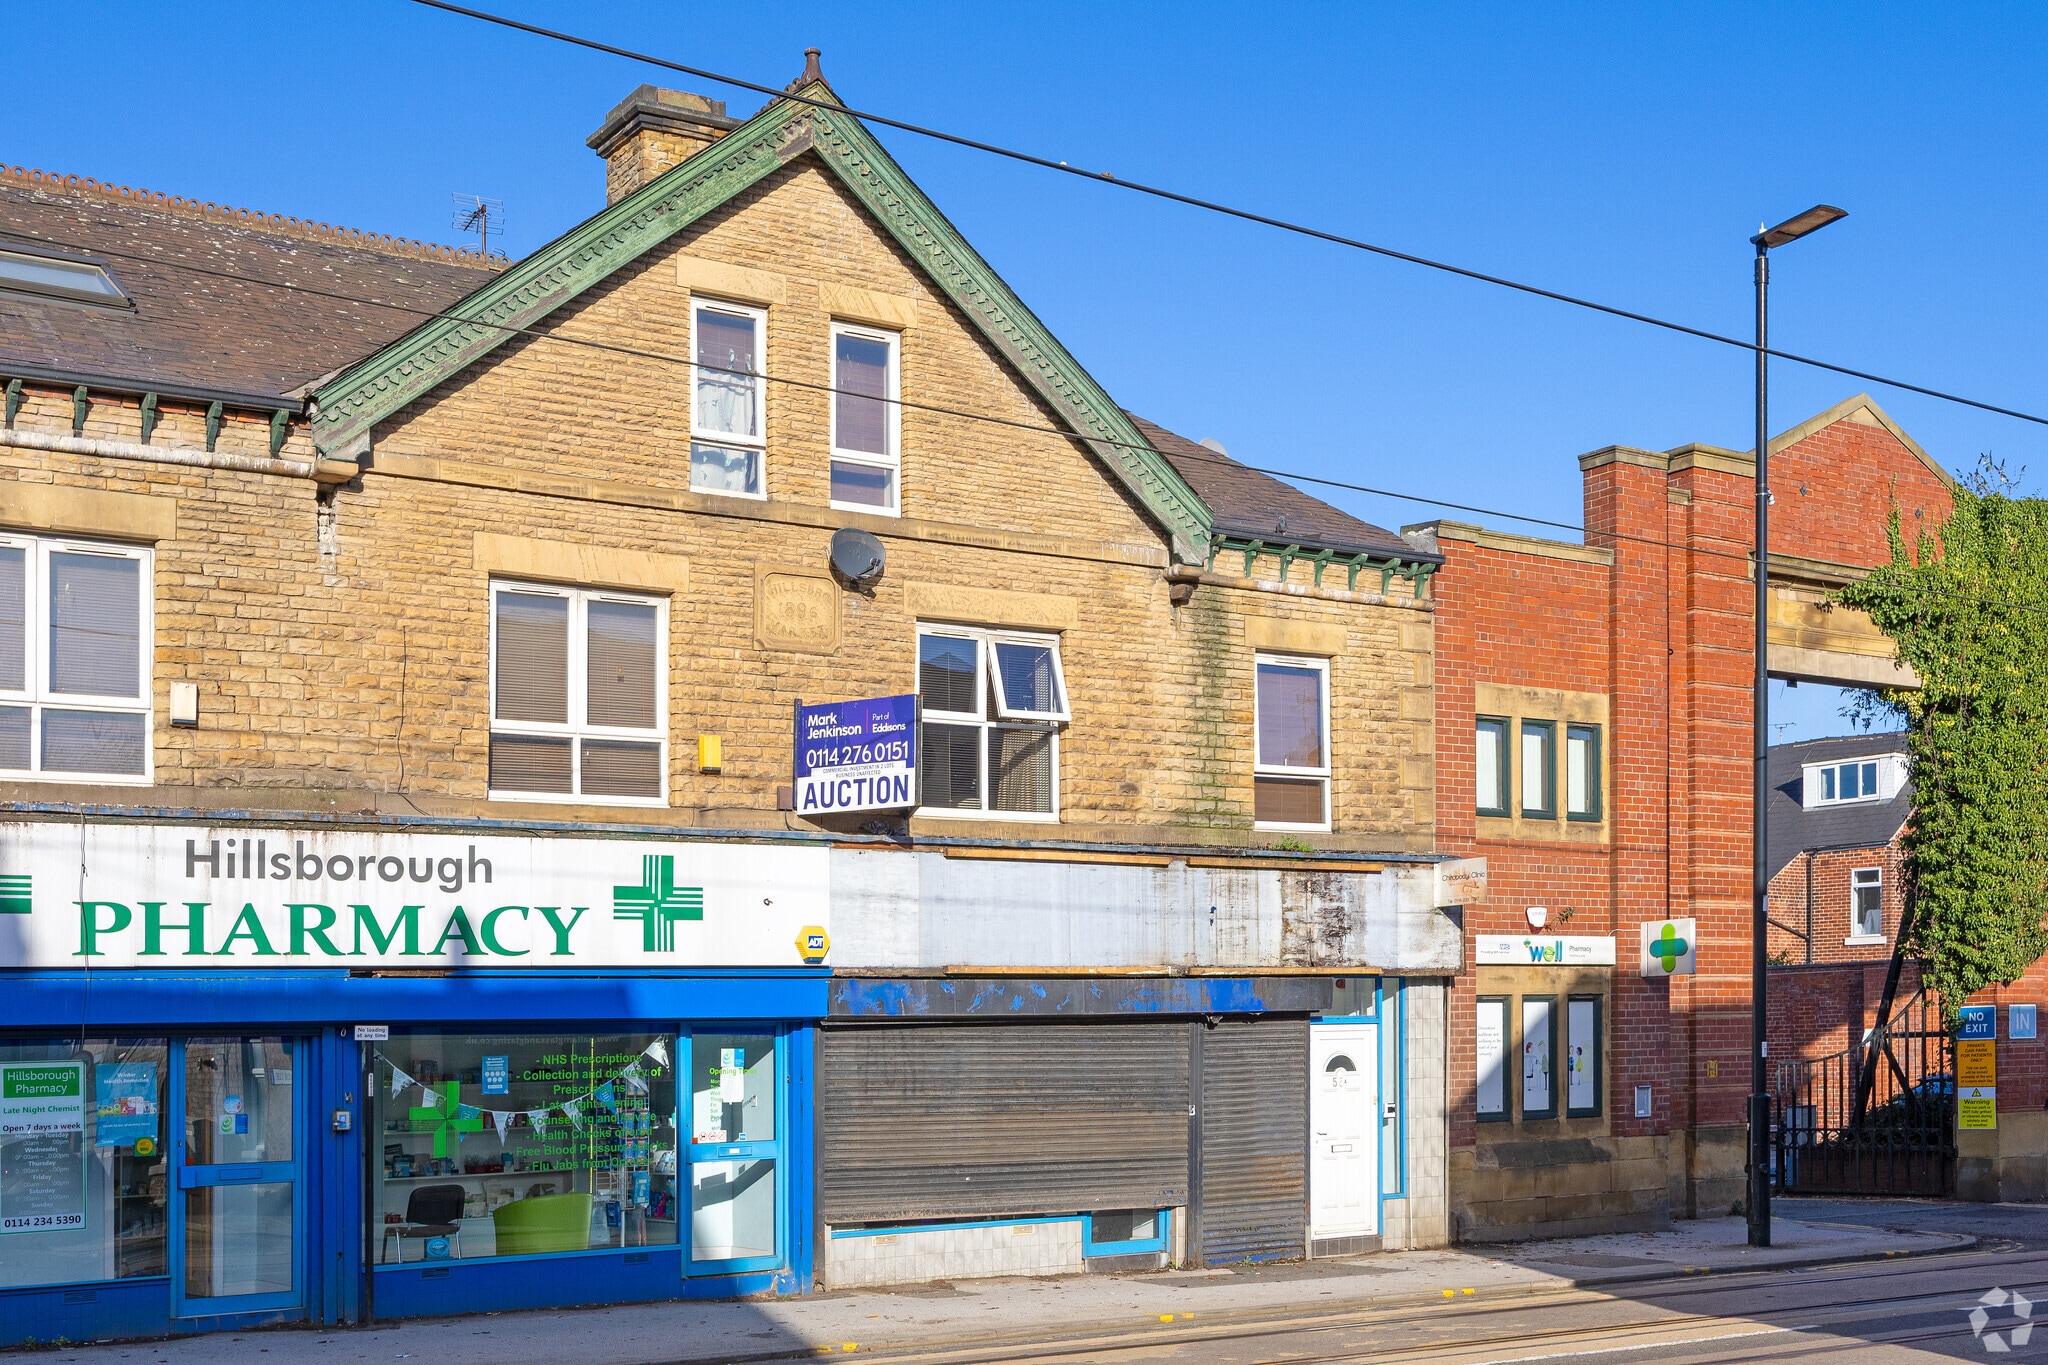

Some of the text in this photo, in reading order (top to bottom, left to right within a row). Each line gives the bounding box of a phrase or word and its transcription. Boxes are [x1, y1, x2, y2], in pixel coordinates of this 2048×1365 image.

[808, 712, 837, 727] Mark
[873, 712, 890, 721] Part of
[808, 725, 862, 740] Jenkinson
[873, 722, 906, 734] Eddisons
[806, 741, 908, 768] 0114 276 0151
[803, 775, 908, 810] AUCTION
[185, 839, 493, 893] Hillsborough
[72, 901, 590, 956] PHARMACY
[808, 937, 824, 948] ADT
[1569, 945, 1592, 953] Pharmacy
[1969, 1012, 1984, 1021] NO
[2016, 1013, 2030, 1030] IN
[1966, 1024, 1988, 1033] EXIT
[543, 1053, 642, 1065] NHS Prescriptions
[8, 1070, 76, 1082] Hillsborough
[523, 1067, 662, 1081] Collection and delivery of
[710, 1068, 736, 1076] Opening
[16, 1084, 68, 1095] Pharmacy
[553, 1084, 626, 1095] Prescrns
[23, 1106, 46, 1115] Night
[48, 1105, 80, 1113] Chemist
[542, 1101, 565, 1110] Late
[570, 1099, 597, 1111] night
[528, 1115, 594, 1126] Counselling
[598, 1113, 617, 1123] and
[3, 1125, 24, 1133] Open
[34, 1123, 52, 1132] days
[60, 1122, 81, 1130] week
[533, 1126, 652, 1140] Health Checks offered
[516, 1147, 540, 1157] Free
[544, 1145, 576, 1155] Blood
[580, 1143, 627, 1154] Pressure
[532, 1161, 551, 1171] Flu
[553, 1159, 579, 1170] Jabs
[582, 1159, 608, 1168] from
[5, 1215, 81, 1228] 0114 234 5390
